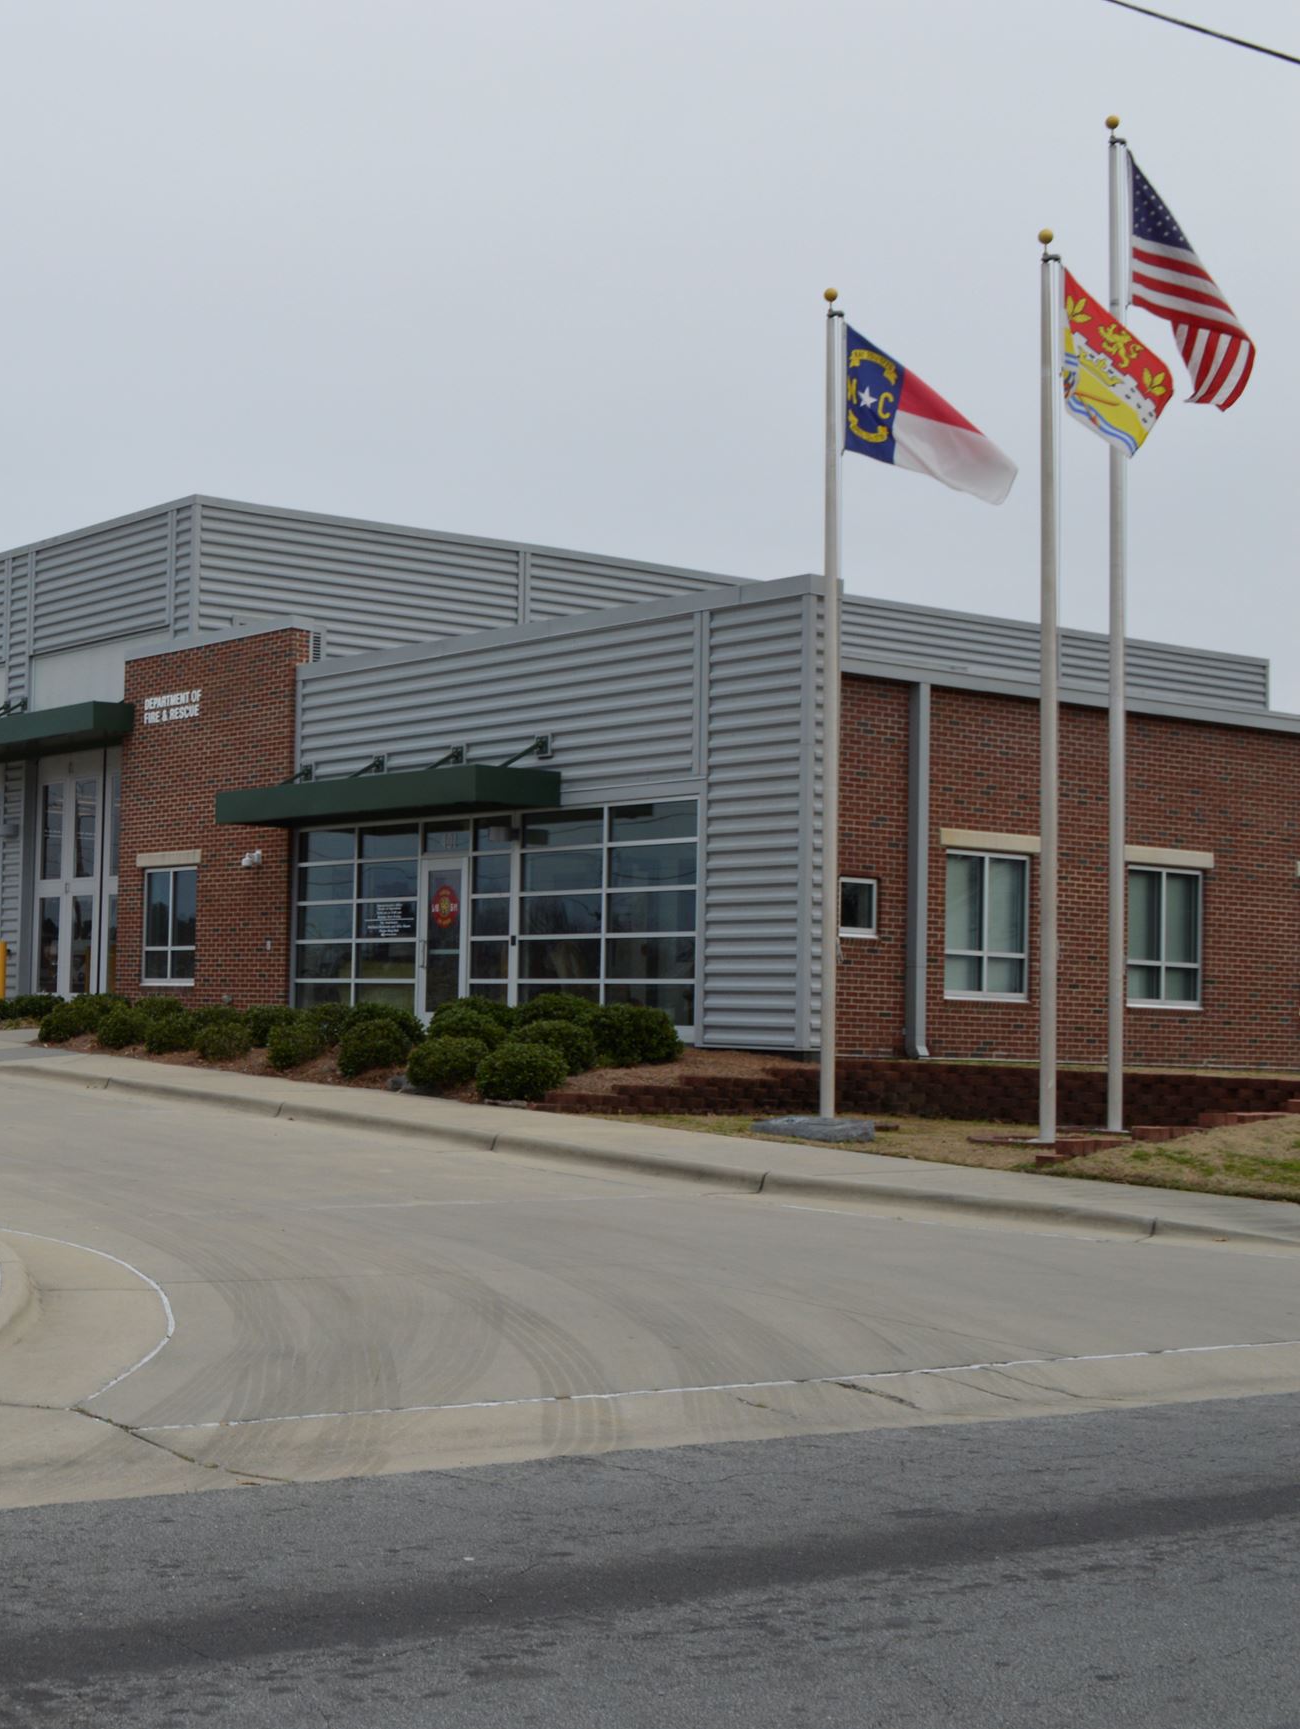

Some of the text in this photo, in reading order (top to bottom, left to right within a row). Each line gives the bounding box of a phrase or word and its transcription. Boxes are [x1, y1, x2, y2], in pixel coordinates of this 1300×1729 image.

[877, 391, 895, 419] C
[144, 689, 203, 711] DEPARTMENT OF
[143, 704, 200, 725] FIRE & RESCUE
